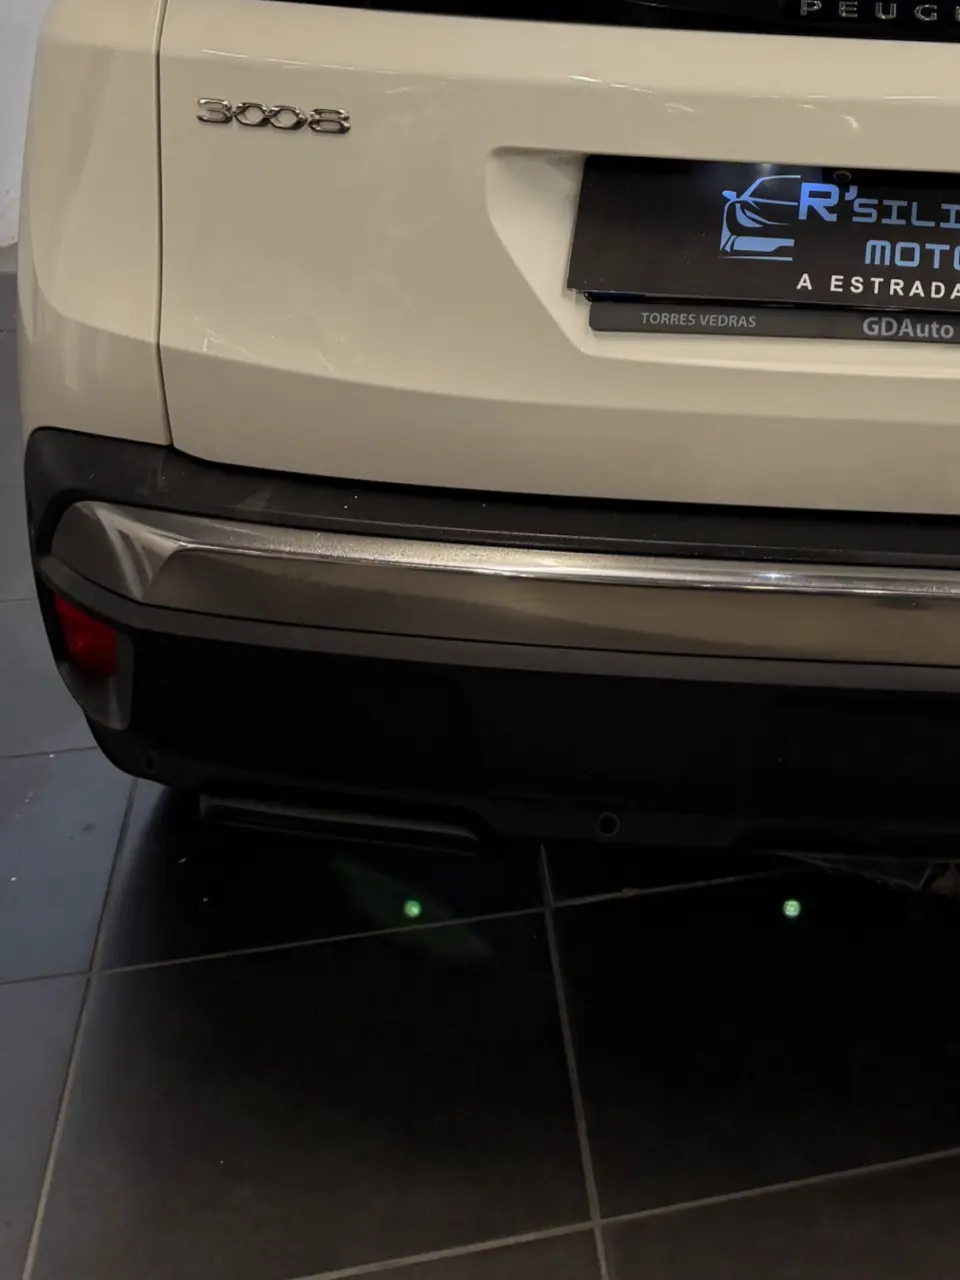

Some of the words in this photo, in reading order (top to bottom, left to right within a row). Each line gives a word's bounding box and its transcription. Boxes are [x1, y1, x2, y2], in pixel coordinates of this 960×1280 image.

[196, 96, 351, 135] 3008
[796, 273, 813, 291] A
[641, 312, 696, 326] TORRES
[699, 314, 756, 328] VEDRAS
[862, 316, 955, 339] GDAuto
